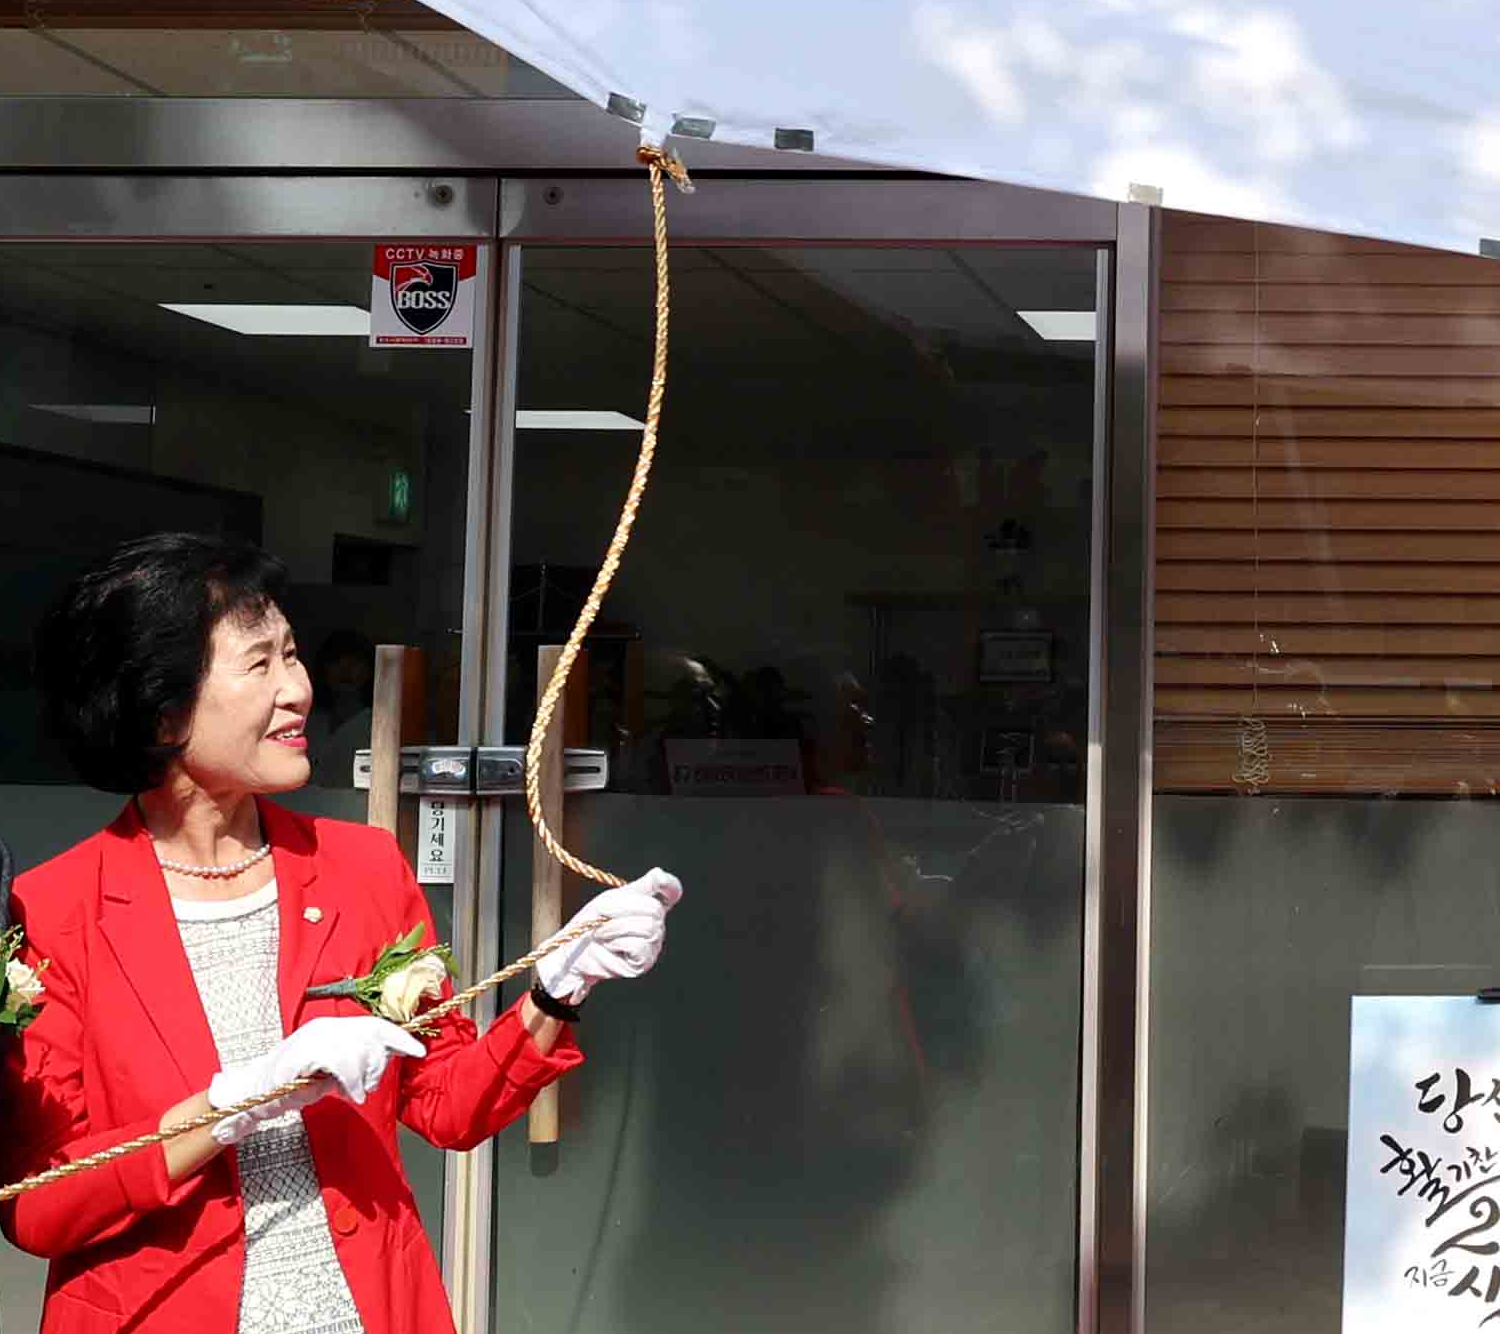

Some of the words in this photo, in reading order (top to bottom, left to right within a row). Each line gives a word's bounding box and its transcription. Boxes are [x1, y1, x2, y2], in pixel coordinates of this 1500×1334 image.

[386, 248, 425, 259] CCTV
[397, 291, 450, 309] BOSS
[1380, 1135, 1499, 1226] 활기찬
[1404, 1259, 1455, 1288] 지금
